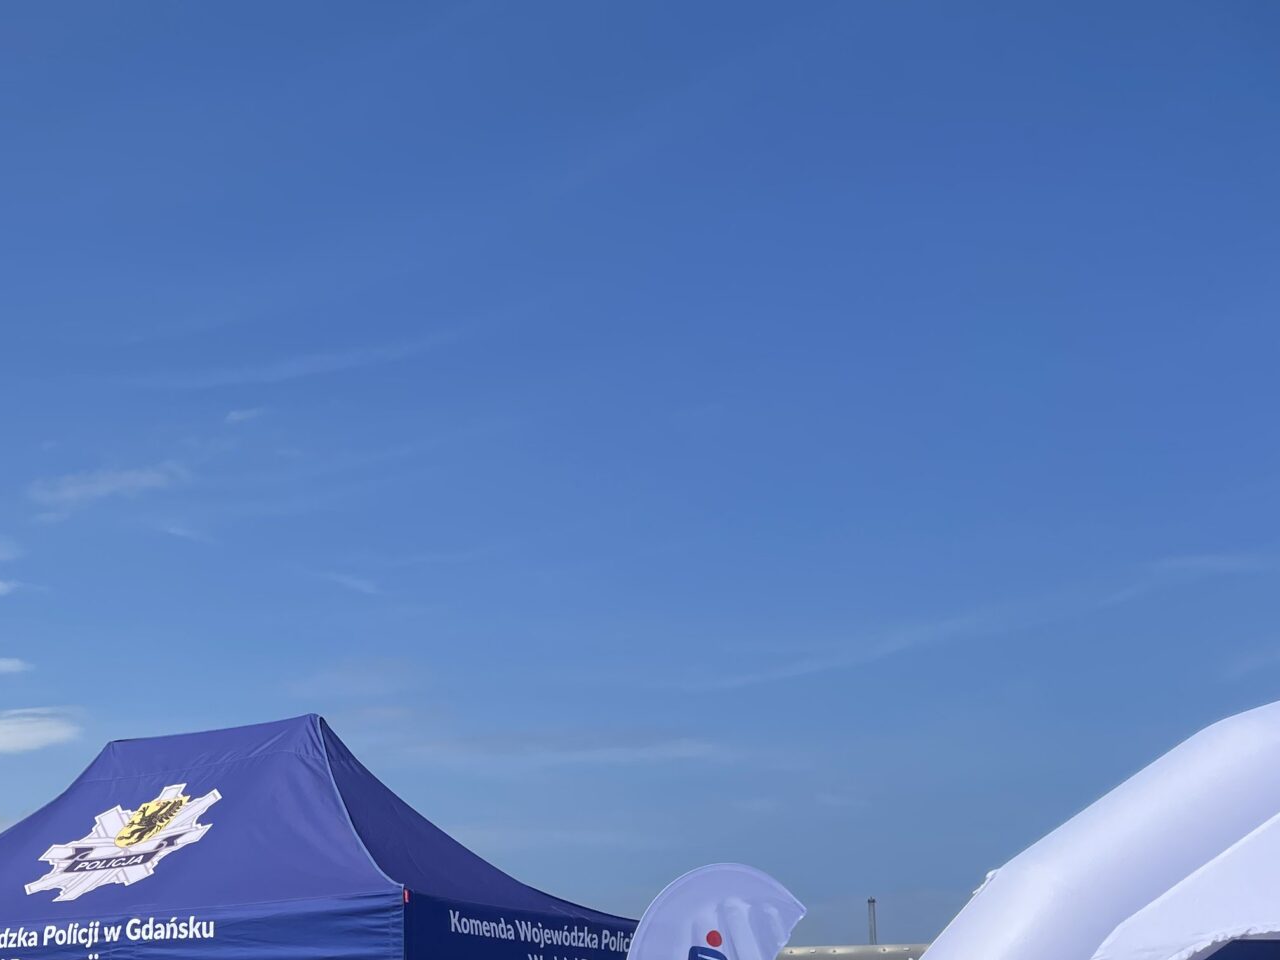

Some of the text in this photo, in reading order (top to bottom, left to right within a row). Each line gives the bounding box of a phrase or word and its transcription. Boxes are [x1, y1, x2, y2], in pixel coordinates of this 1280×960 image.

[73, 854, 145, 872] POLICJA
[43, 921, 100, 948] Policji
[103, 925, 122, 942] w
[125, 915, 216, 942] Gdańsku
[449, 910, 633, 953] Komenda Wojewódzka Polic
